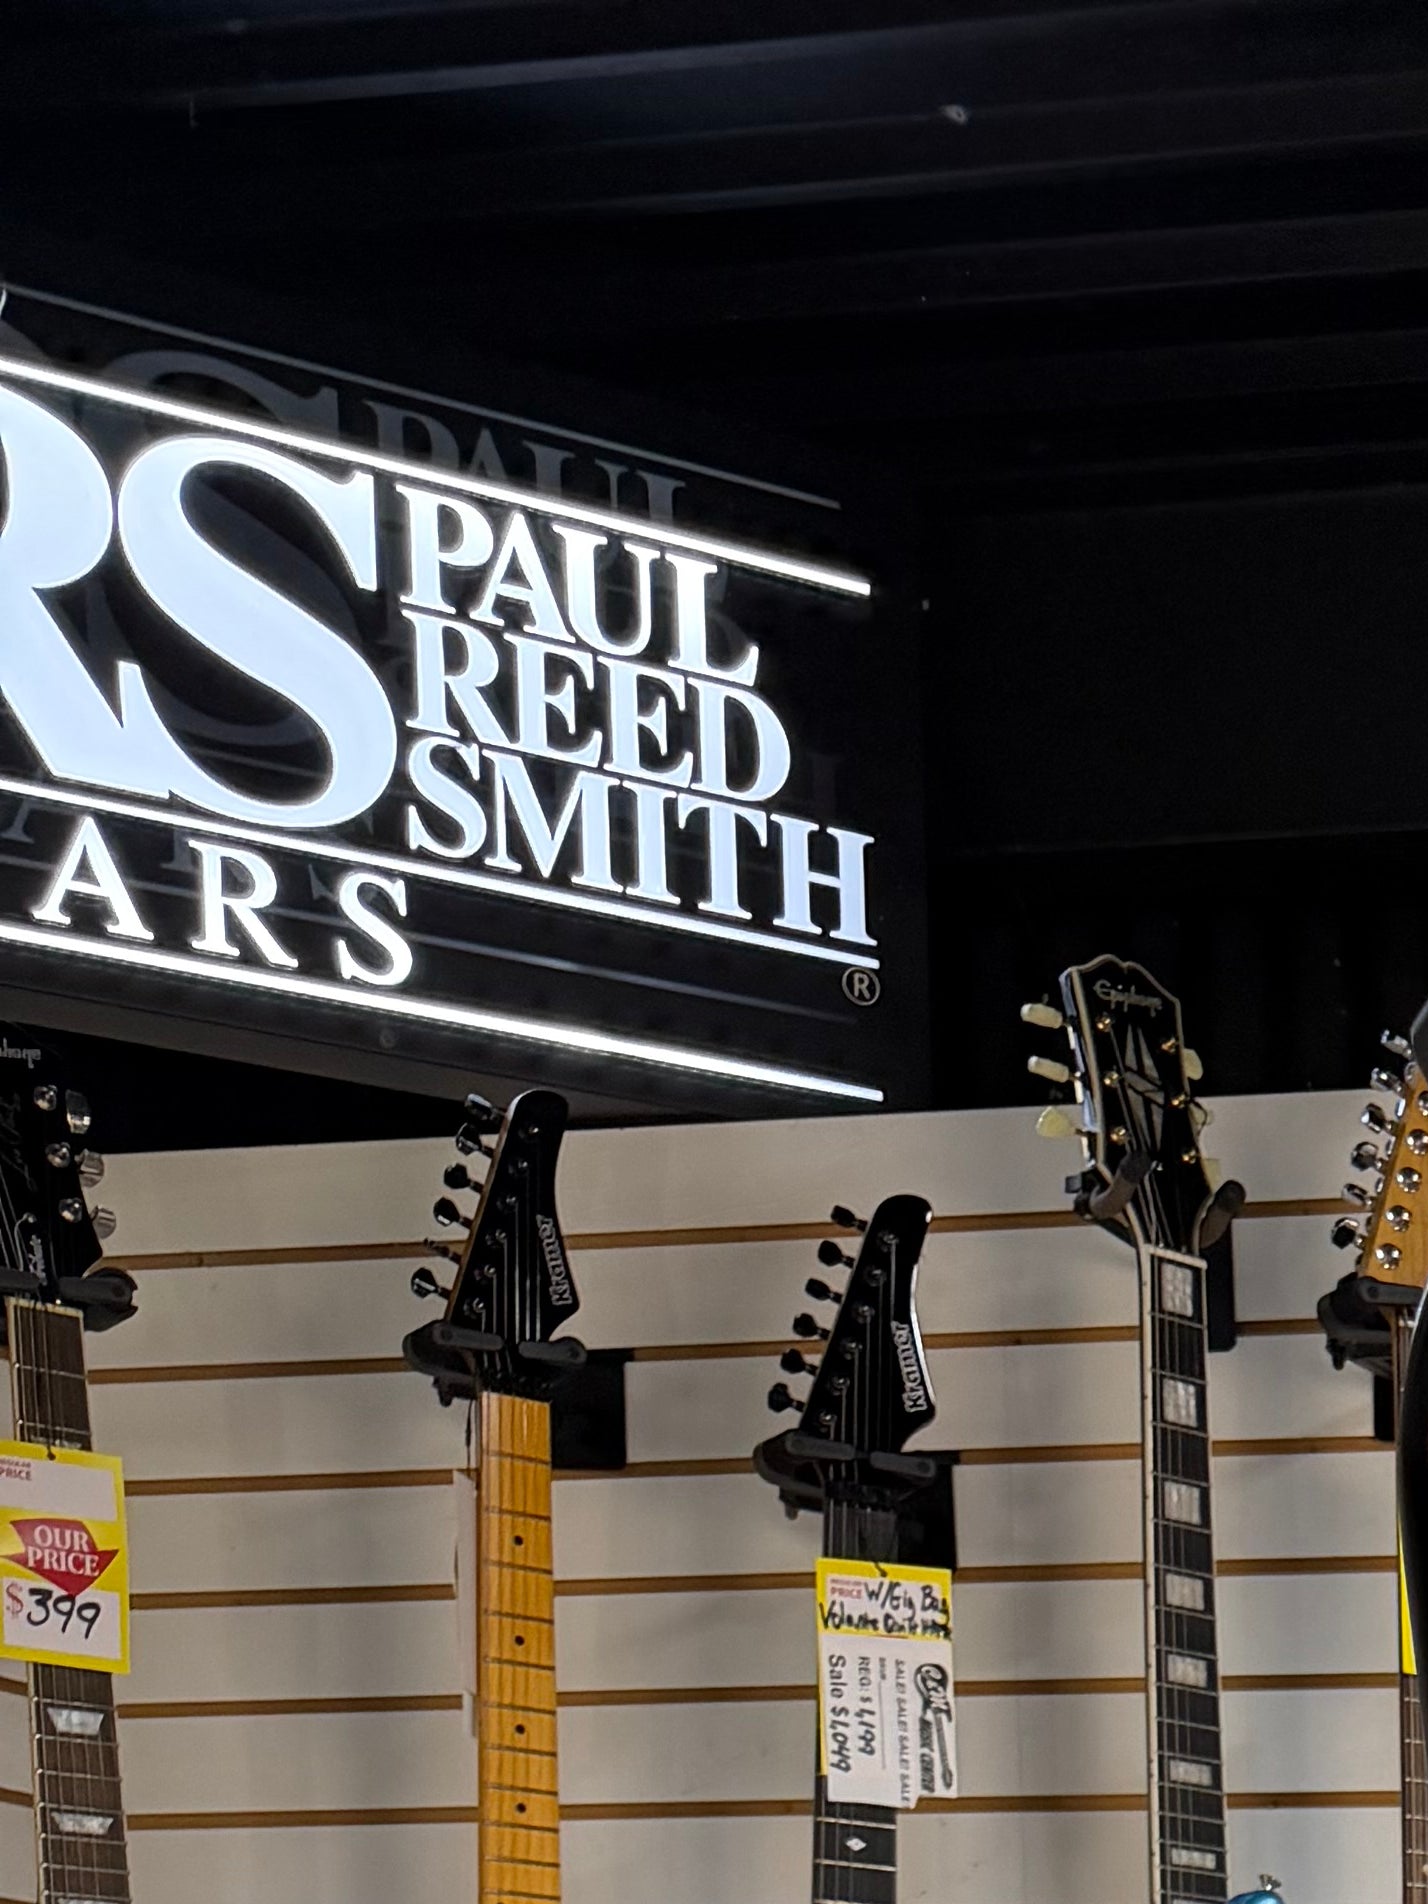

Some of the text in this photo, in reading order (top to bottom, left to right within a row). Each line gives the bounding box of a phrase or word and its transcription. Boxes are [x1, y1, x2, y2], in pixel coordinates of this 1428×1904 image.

[397, 484, 759, 686] PAUL
[402, 609, 792, 803] REED
[407, 735, 880, 947] SMITH
[536, 1214, 574, 1307] Kramer
[889, 1320, 929, 1413] Kramer
[27, 1546, 101, 1578] PRICE
[33, 1525, 90, 1554] OUR
[6, 1583, 102, 1641] $399
[828, 1654, 848, 1699] Sale
